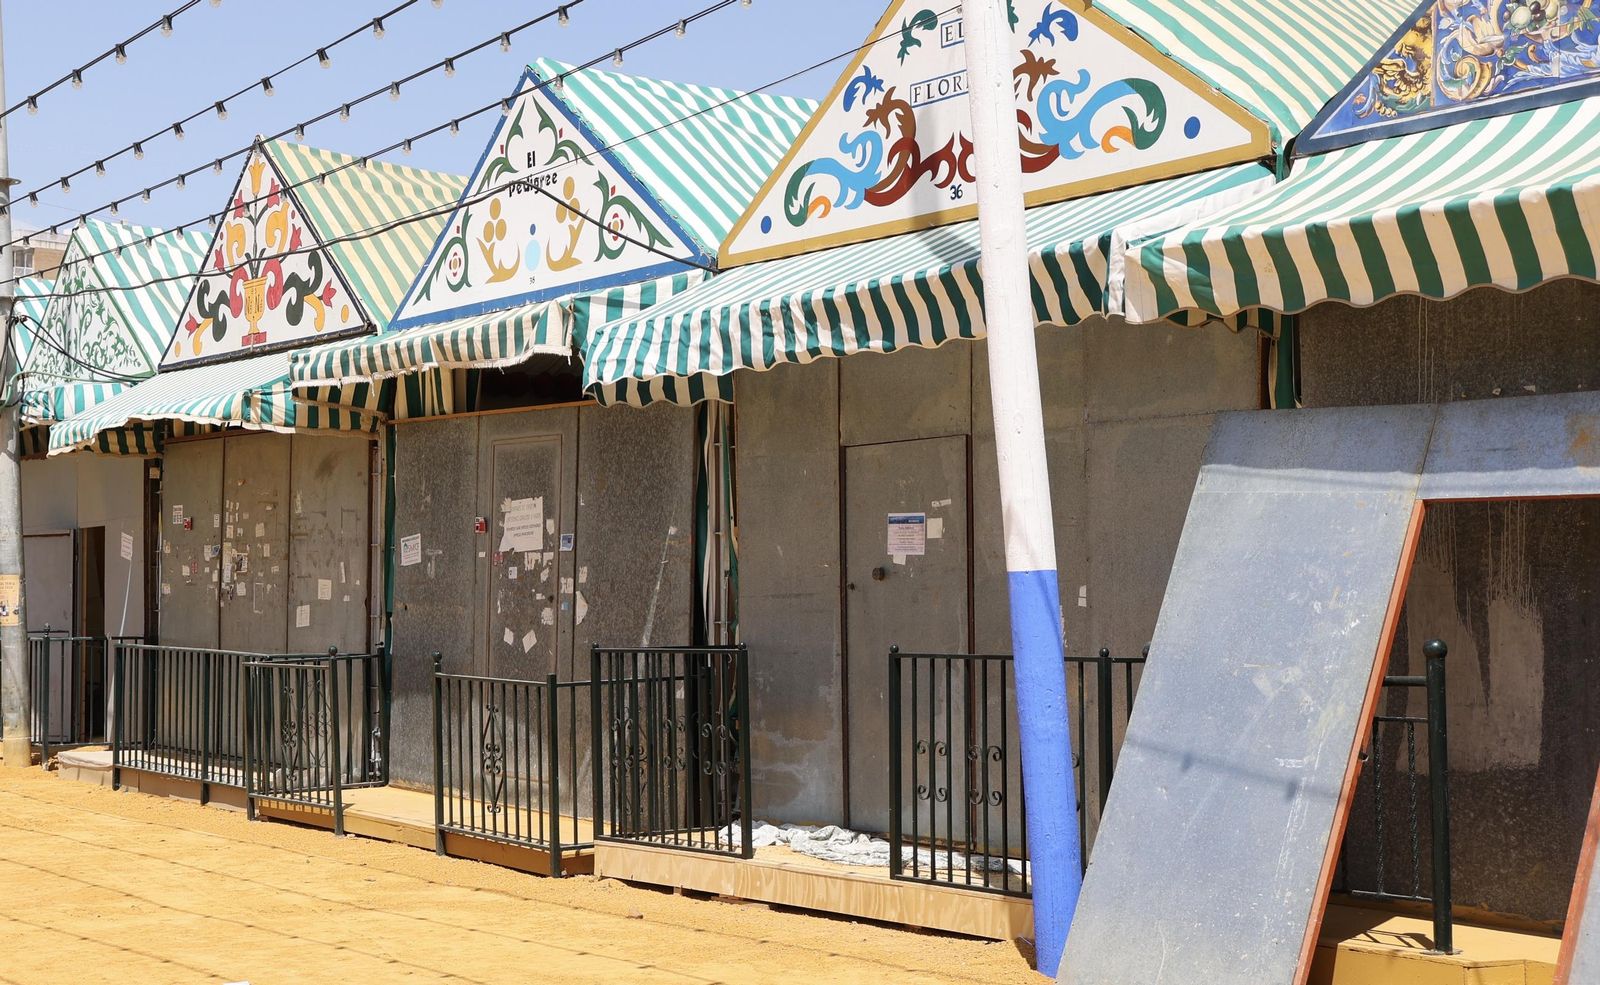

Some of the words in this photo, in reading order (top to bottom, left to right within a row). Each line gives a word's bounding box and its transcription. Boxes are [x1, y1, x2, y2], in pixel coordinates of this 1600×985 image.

[945, 22, 964, 42] EL
[527, 151, 535, 168] El
[950, 184, 963, 200] 36
